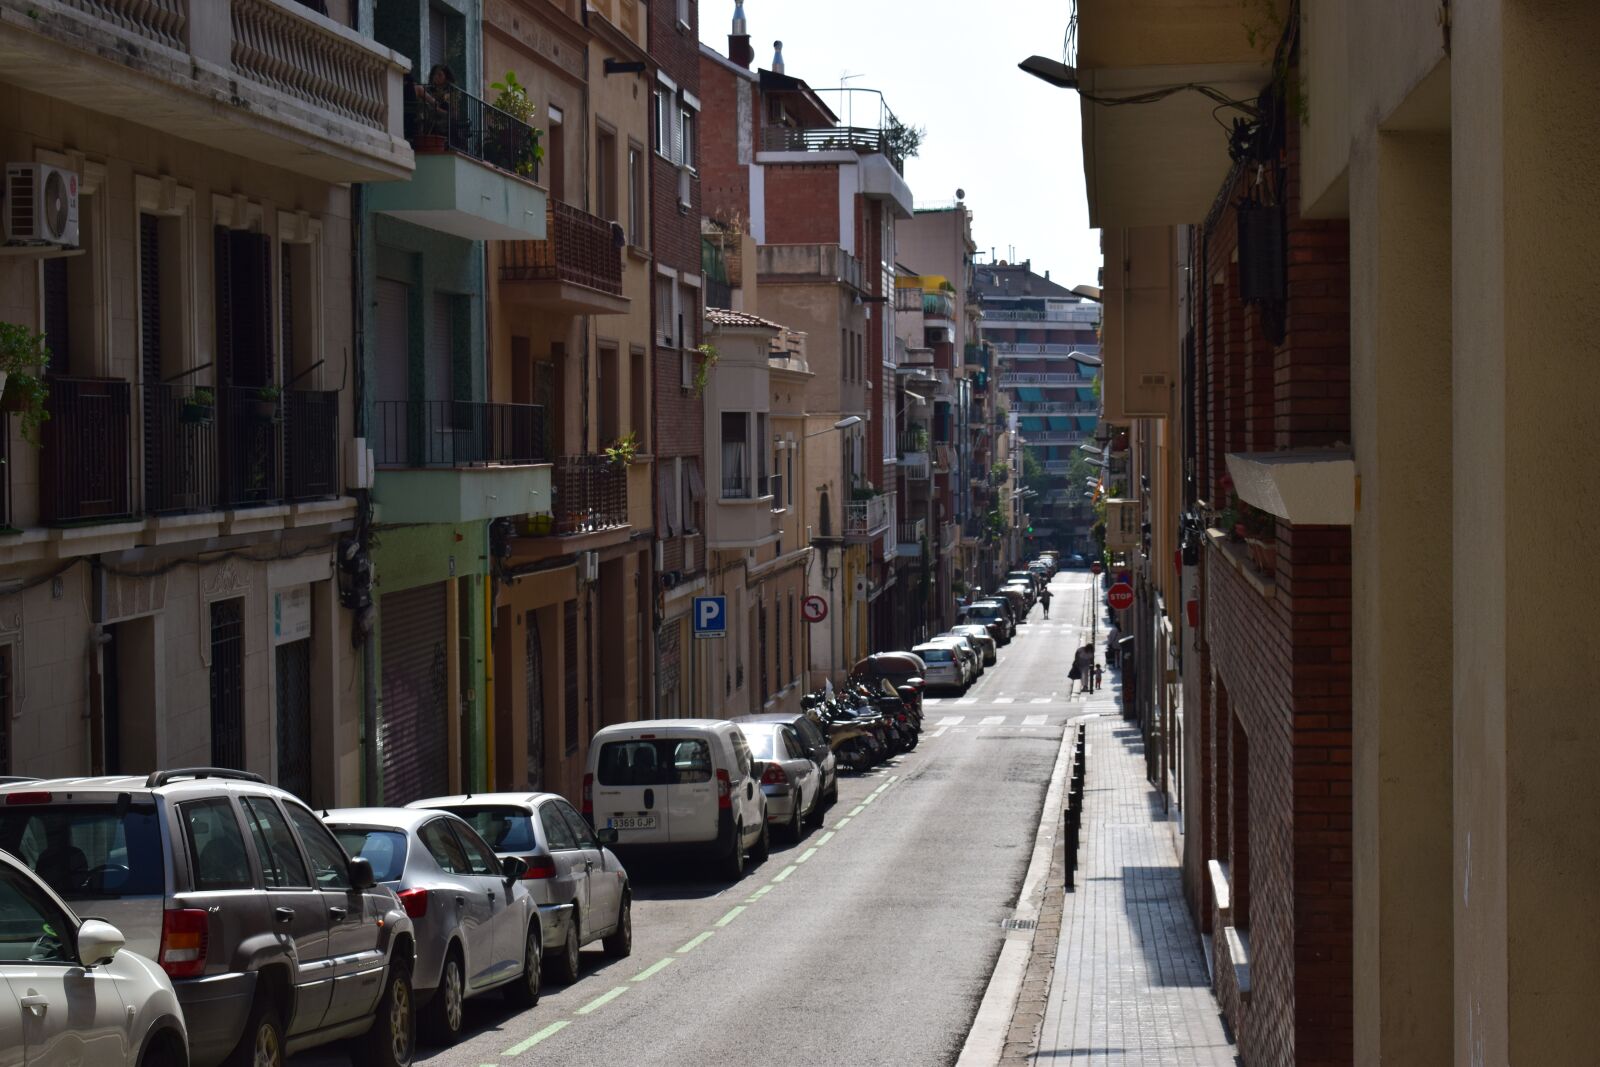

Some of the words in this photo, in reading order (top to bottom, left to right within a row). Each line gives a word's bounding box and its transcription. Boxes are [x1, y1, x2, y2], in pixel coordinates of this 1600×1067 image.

[701, 601, 720, 628] P
[613, 817, 635, 828] 3369
[637, 817, 654, 827] GJP
